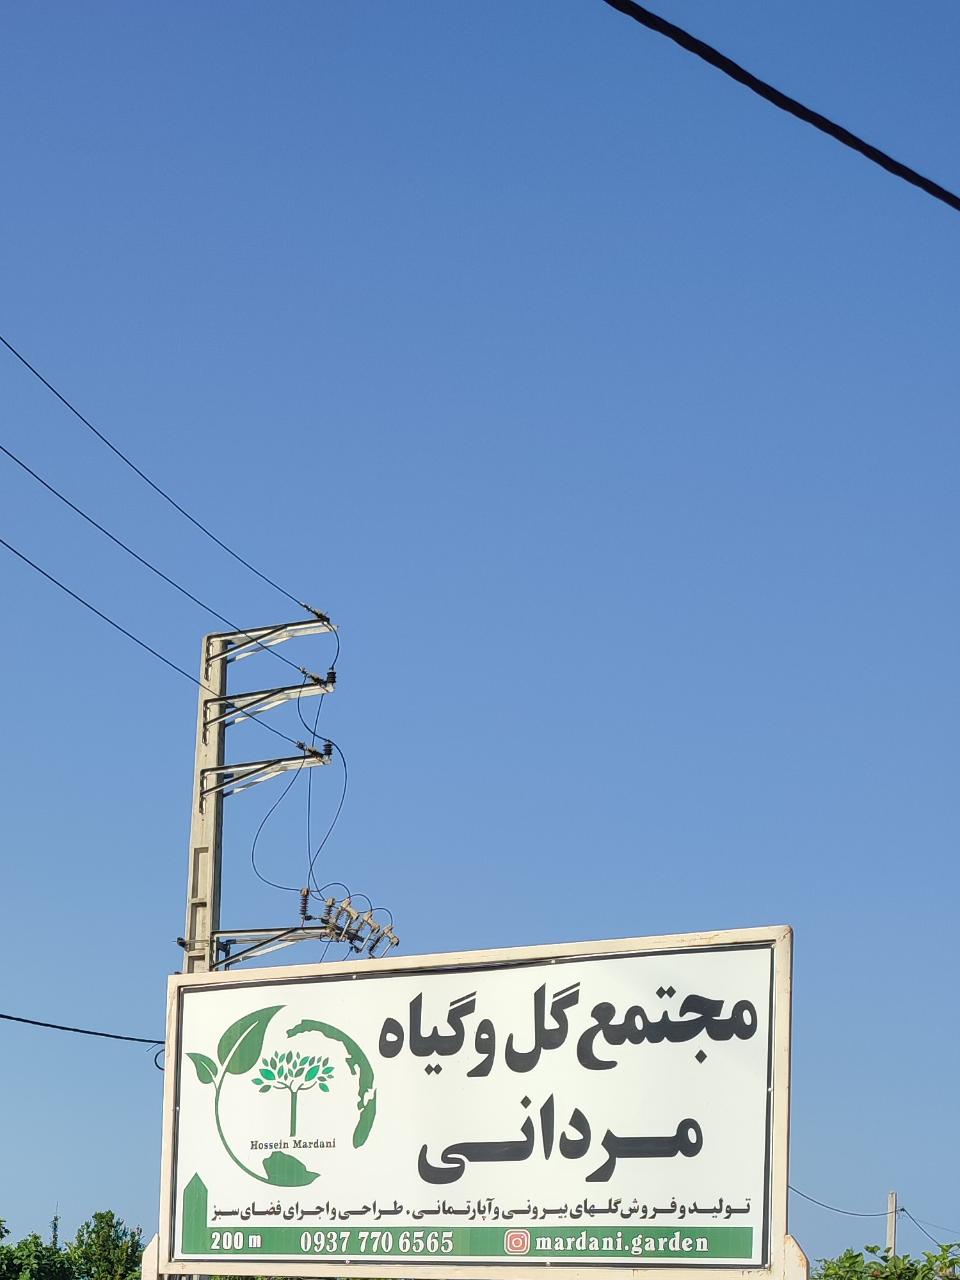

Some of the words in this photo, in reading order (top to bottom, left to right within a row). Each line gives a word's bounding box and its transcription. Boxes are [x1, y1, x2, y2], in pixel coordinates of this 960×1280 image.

[378, 991, 477, 1076] گیاه
[504, 981, 581, 1073] گل
[576, 985, 758, 1071] مجتمع
[250, 1139, 290, 1150] Hossein
[292, 1138, 336, 1149] Mardani
[417, 1094, 704, 1185] مردانی
[211, 1203, 240, 1221] سبز
[240, 1201, 282, 1221] فضای
[282, 1201, 330, 1221] اجرای
[338, 1200, 404, 1221] طراحی
[501, 1200, 568, 1220] بیرونی
[569, 1197, 622, 1220] گلهای
[620, 1197, 678, 1220] فروش
[688, 1197, 751, 1220] تولید
[210, 1231, 244, 1250] 200
[248, 1234, 262, 1248] m
[300, 1231, 351, 1253] 0937
[358, 1231, 393, 1253] 770
[398, 1231, 453, 1253] 6565
[535, 1230, 709, 1255] mardani.garden
